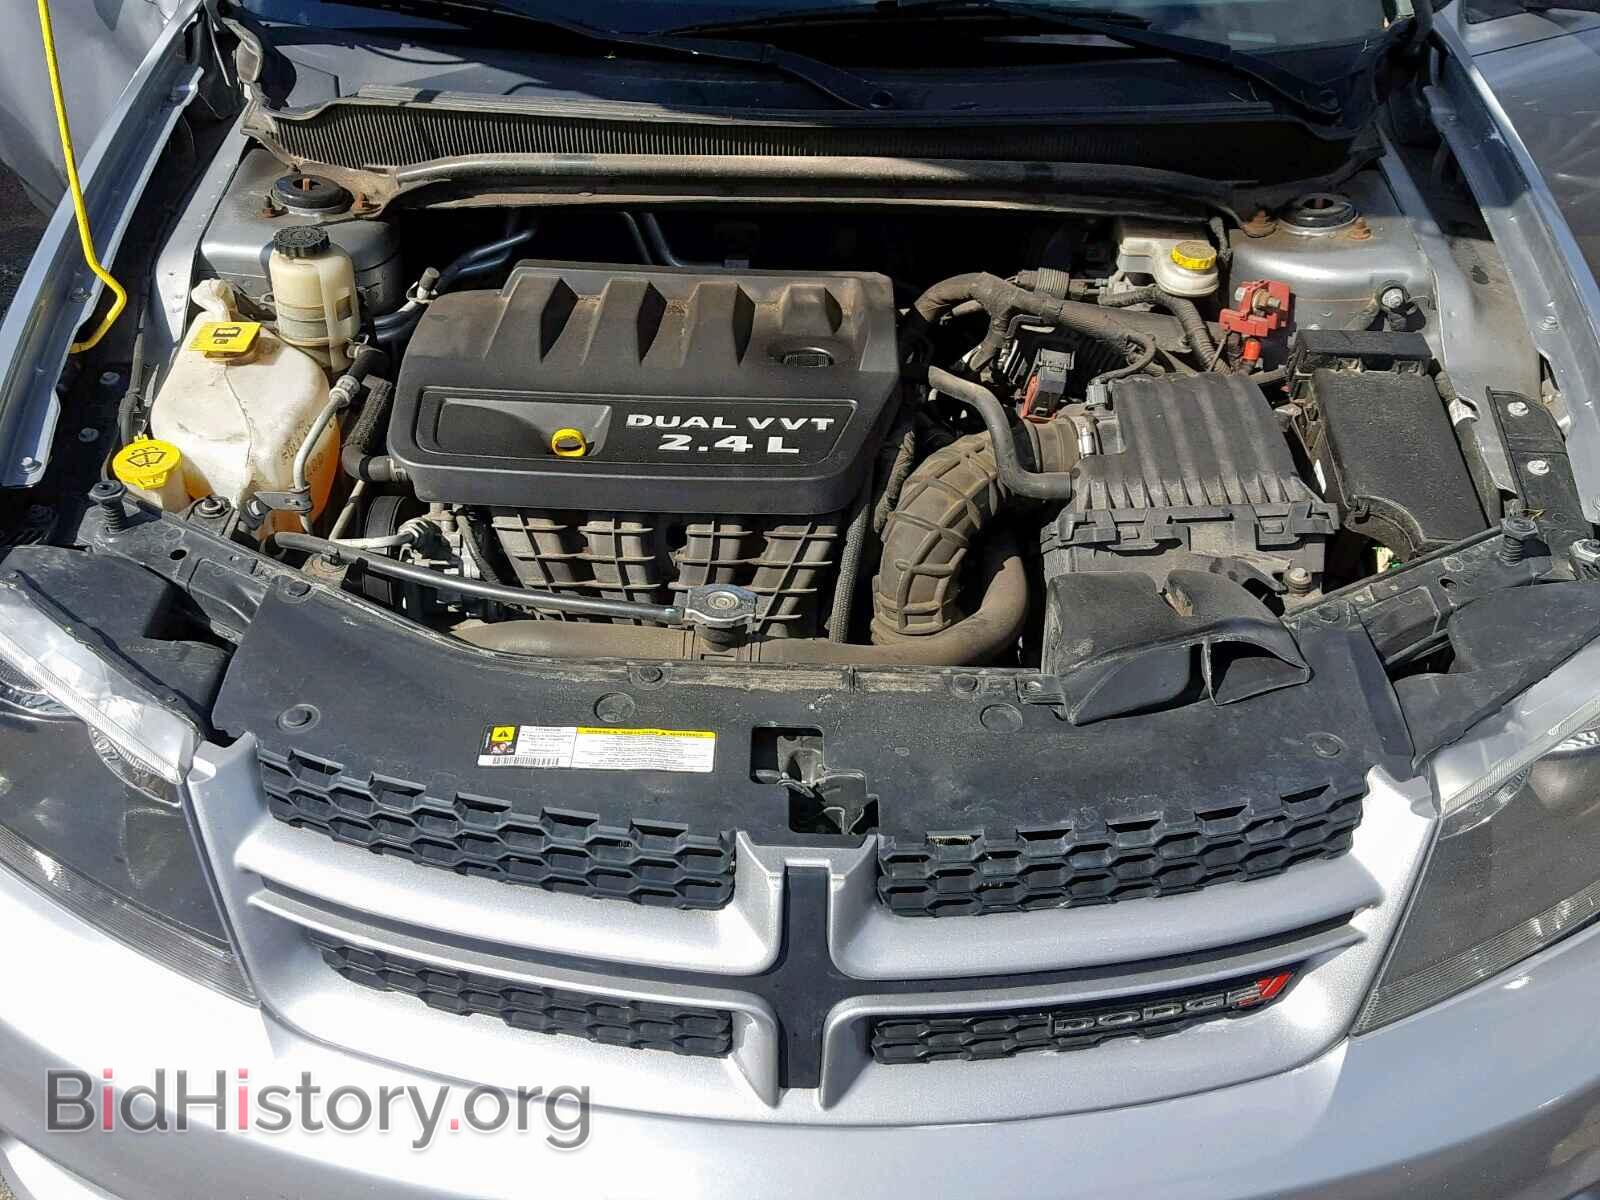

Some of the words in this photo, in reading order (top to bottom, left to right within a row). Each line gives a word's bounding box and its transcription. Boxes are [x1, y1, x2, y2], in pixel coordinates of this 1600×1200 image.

[626, 414, 737, 429] DUAL
[747, 416, 835, 430] VVT
[1054, 984, 1261, 1034] DODGE
